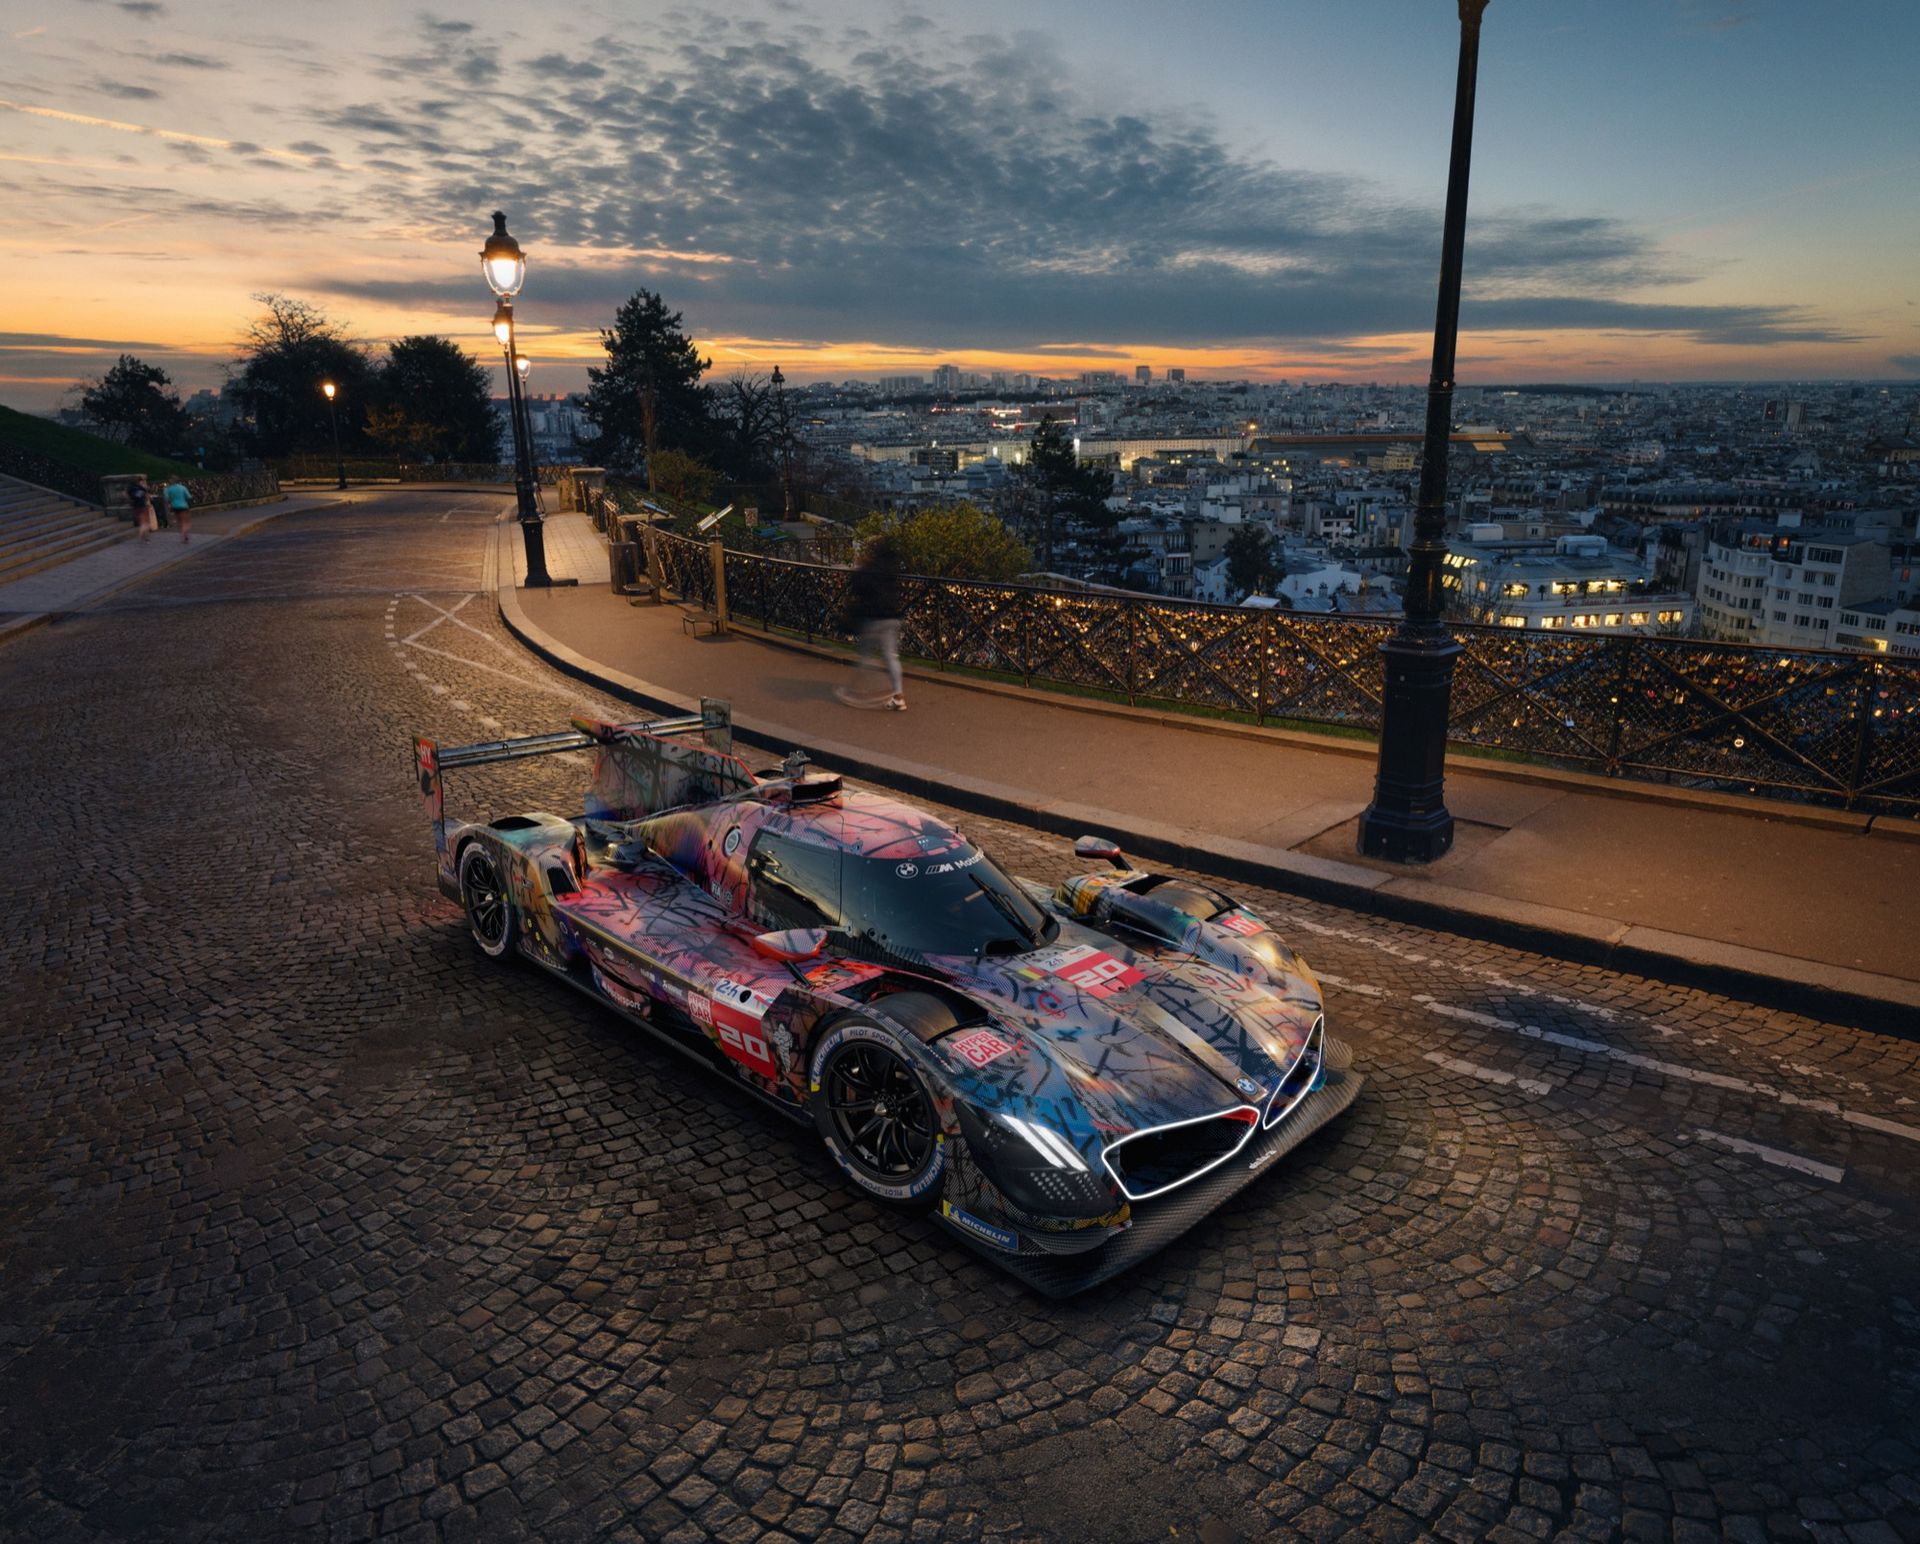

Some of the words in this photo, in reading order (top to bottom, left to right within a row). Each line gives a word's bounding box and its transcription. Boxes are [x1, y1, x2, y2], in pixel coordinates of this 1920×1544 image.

[420, 743, 431, 764] HY
[1227, 916, 1258, 935] HY
[1066, 958, 1129, 989] 20
[716, 1020, 771, 1064] 20
[849, 1028, 868, 1037] PILOT
[871, 1031, 894, 1046] SPORT
[955, 1032, 994, 1053] HYPER
[966, 1039, 1011, 1063] CAR
[912, 1152, 944, 1194] MICHELIN
[961, 1215, 1011, 1243] MICHELIN
